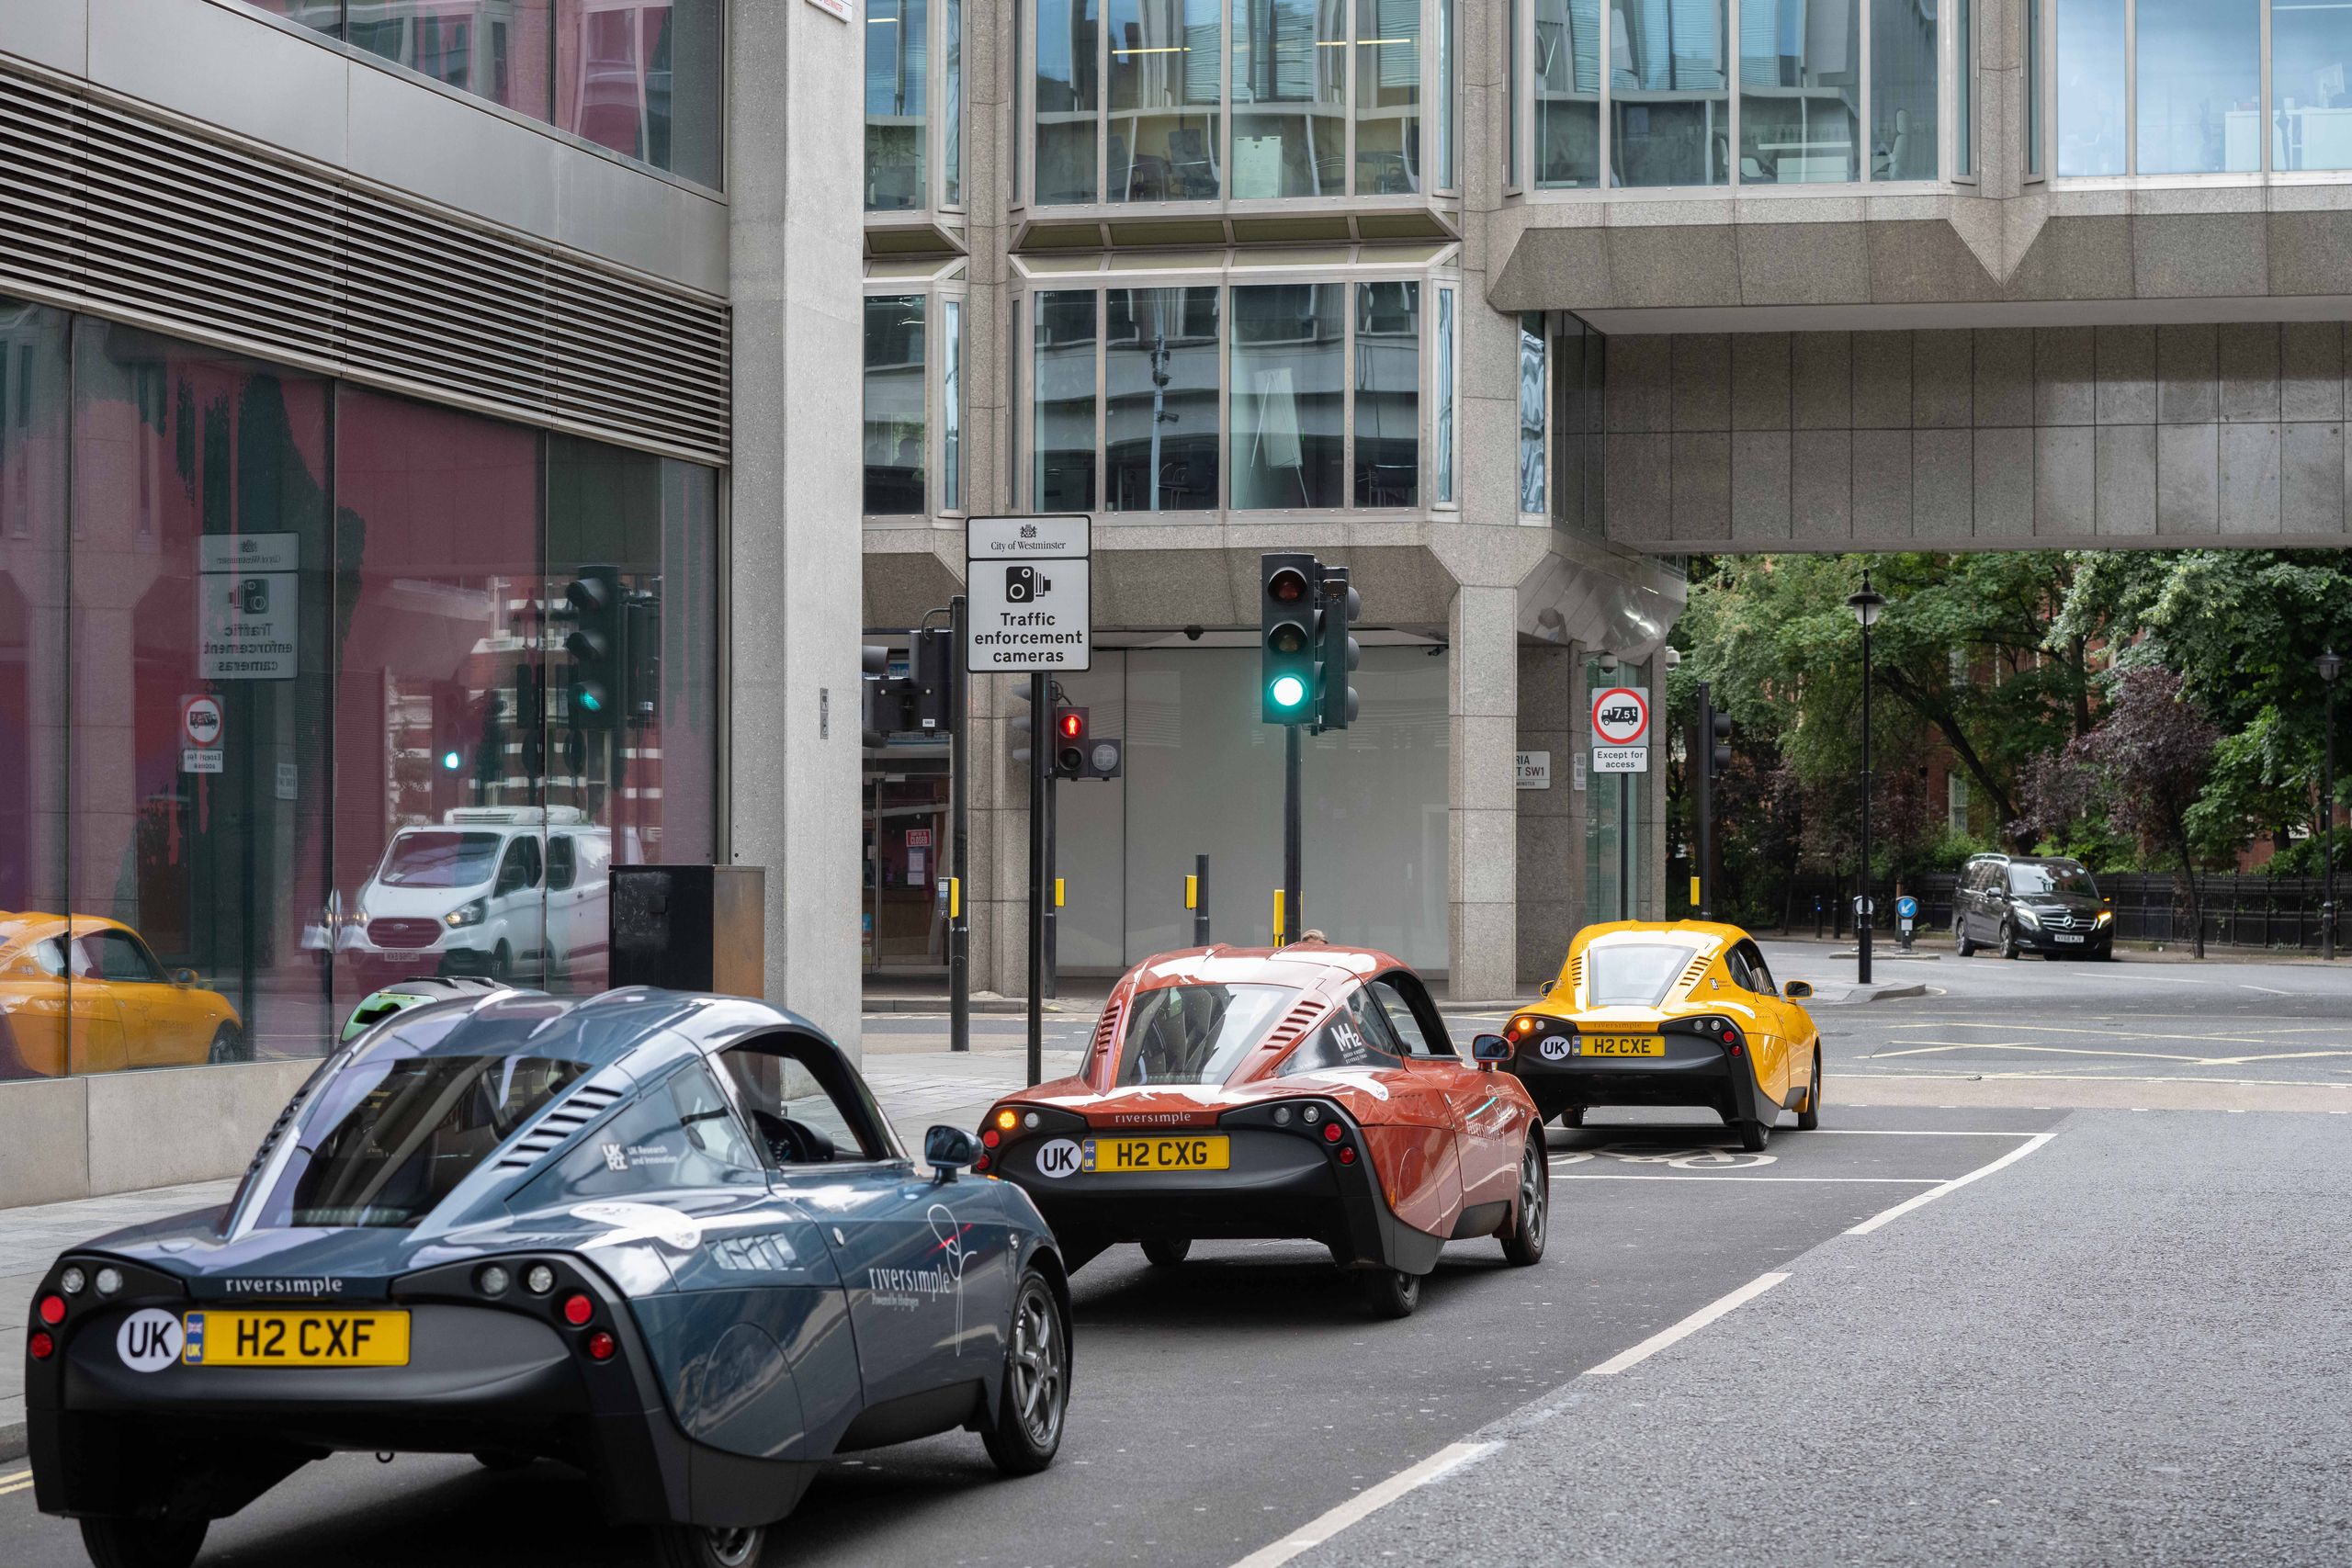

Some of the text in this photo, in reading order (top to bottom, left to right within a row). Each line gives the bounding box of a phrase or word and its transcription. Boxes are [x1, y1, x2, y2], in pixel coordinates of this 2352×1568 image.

[990, 540, 1067, 552] City of Westminster
[1001, 613, 1056, 626] Traffic
[974, 630, 1082, 645] enforcement
[992, 651, 1064, 663] cameras
[1597, 750, 1644, 761] Except for
[1525, 766, 1544, 776] SW1
[1544, 1042, 1566, 1055] UK
[1594, 1038, 1651, 1054] H2 CXE
[1114, 1111, 1192, 1124] riversimple
[1043, 1146, 1075, 1171] UK
[1117, 1141, 1207, 1167] H2 CXG
[1084, 1158, 1094, 1168] UK
[225, 1275, 343, 1297] riversimple
[868, 1263, 951, 1303] riversimple
[128, 1320, 175, 1359] UK
[236, 1318, 375, 1357] H2 CXF
[186, 1343, 201, 1357] UK
